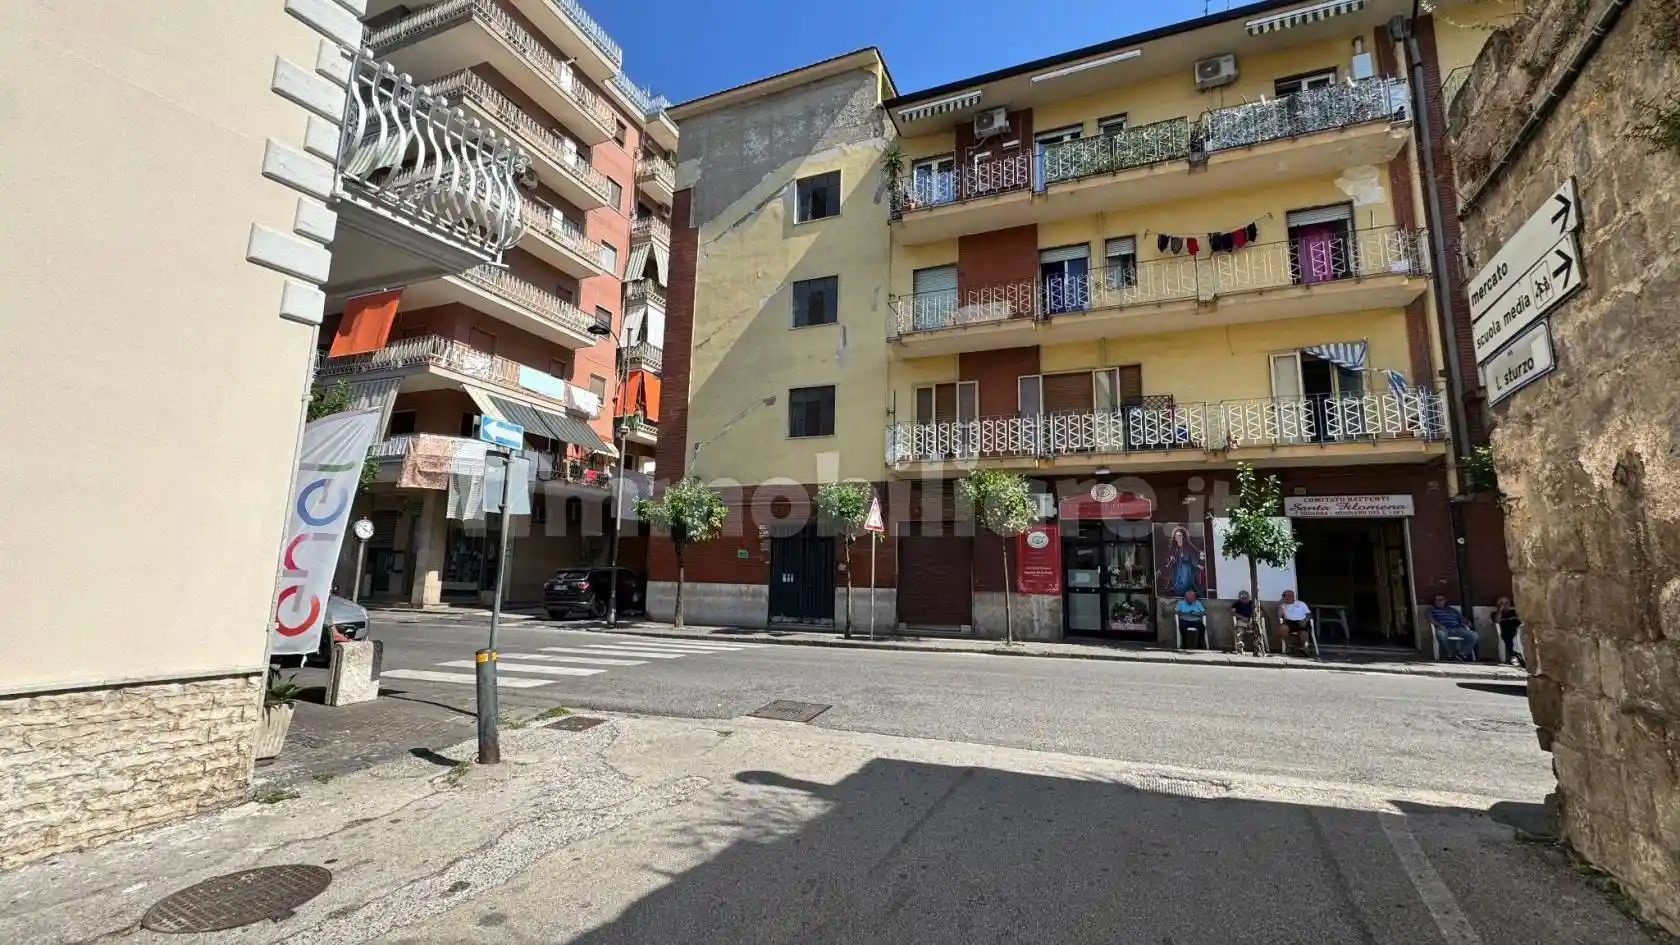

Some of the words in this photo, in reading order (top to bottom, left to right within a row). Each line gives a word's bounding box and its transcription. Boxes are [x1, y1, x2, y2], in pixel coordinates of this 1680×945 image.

[1471, 261, 1509, 307] mercato
[1476, 319, 1502, 349] scuola
[1503, 293, 1531, 327] media
[1504, 357, 1535, 385] sturzo
[1289, 502, 1330, 512] Santa
[1336, 501, 1408, 512] Filomena
[275, 460, 356, 638] enel
